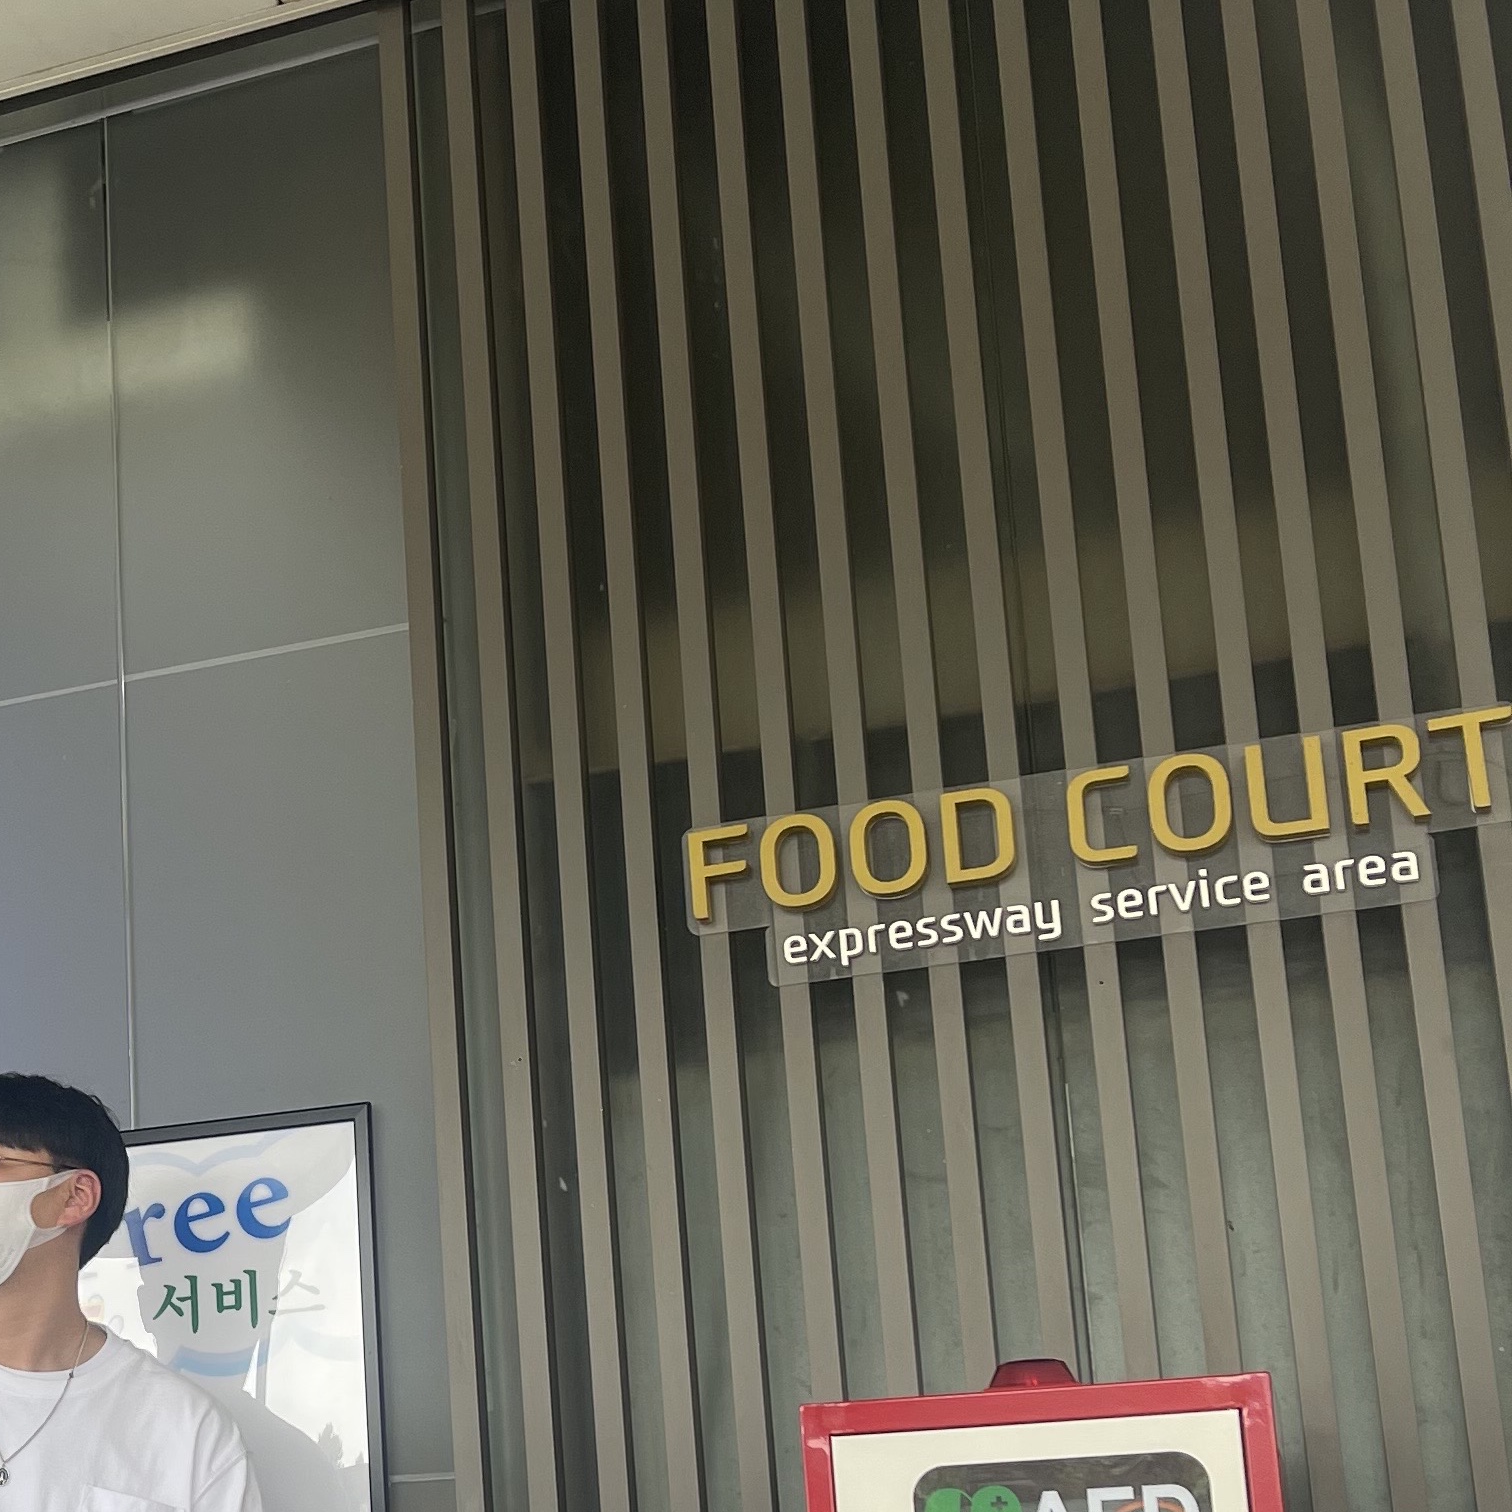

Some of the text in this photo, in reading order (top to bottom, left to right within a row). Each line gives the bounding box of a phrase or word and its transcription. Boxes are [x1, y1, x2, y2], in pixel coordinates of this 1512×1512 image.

[687, 705, 1512, 922] FOOD COURT
[782, 849, 1420, 967] expressway service area
[153, 1269, 326, 1334] 서비스
